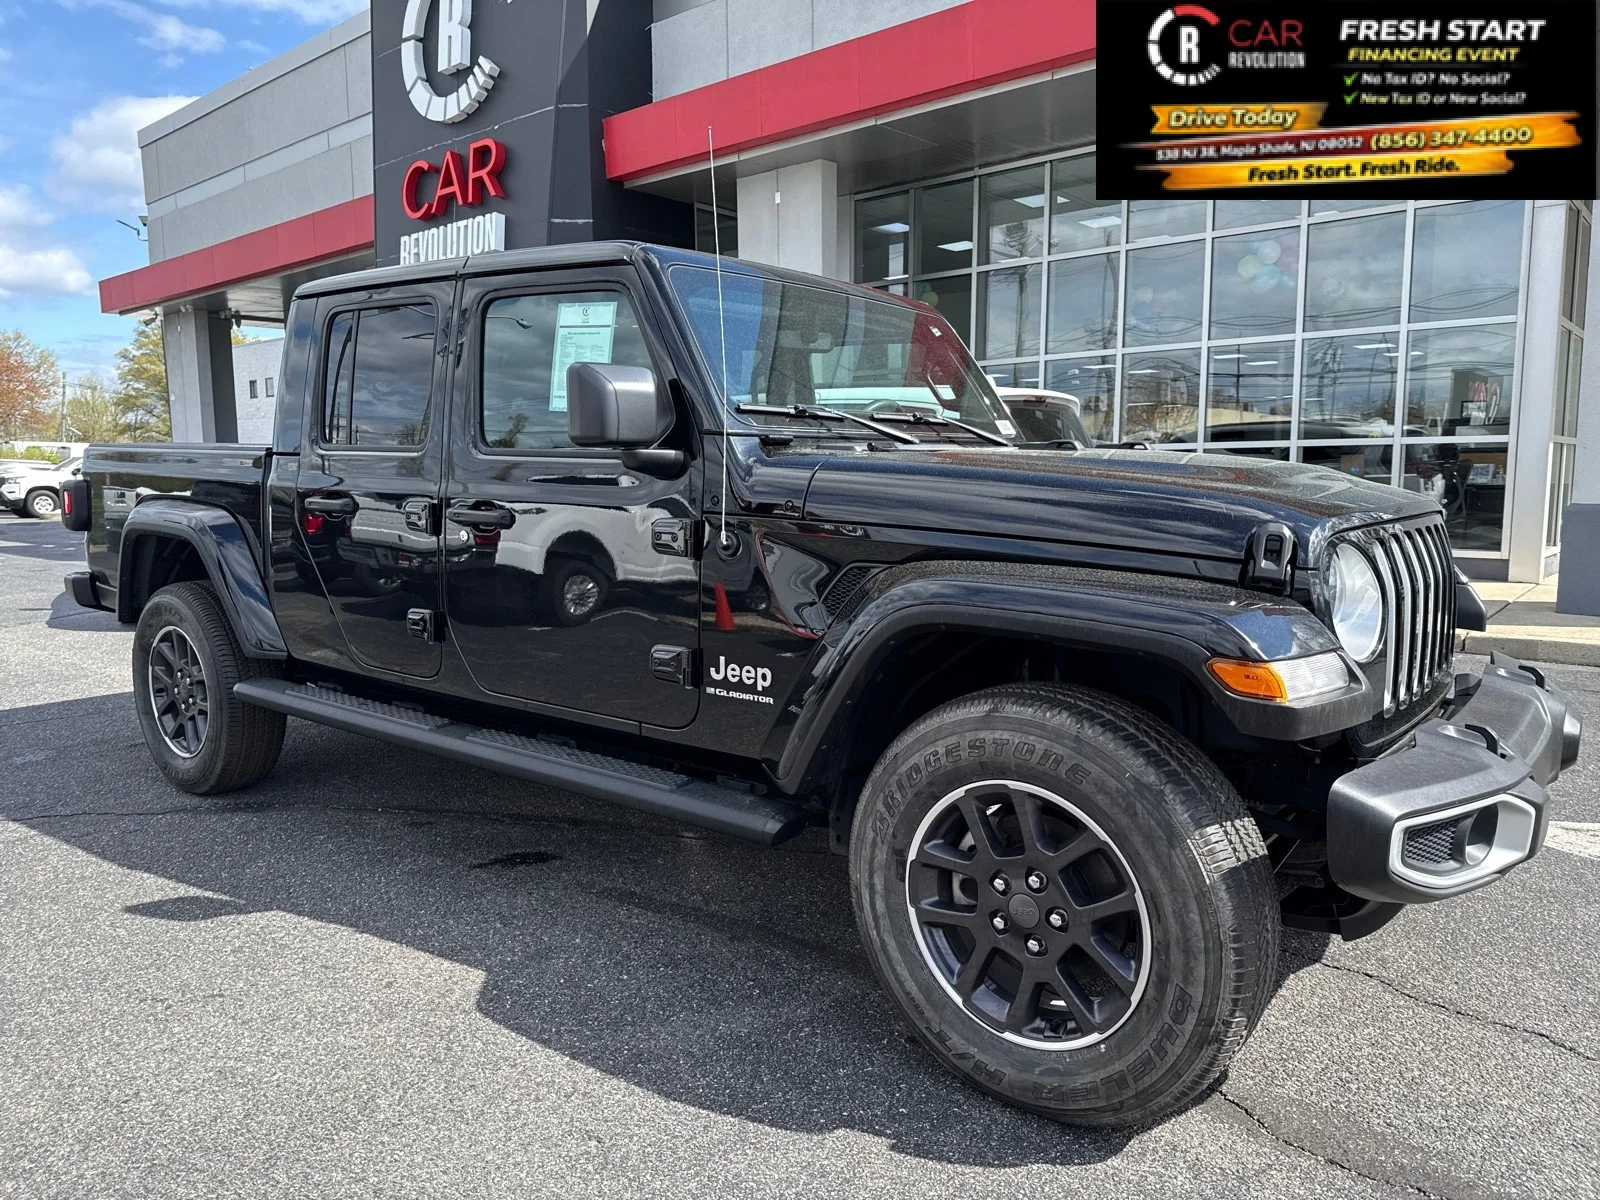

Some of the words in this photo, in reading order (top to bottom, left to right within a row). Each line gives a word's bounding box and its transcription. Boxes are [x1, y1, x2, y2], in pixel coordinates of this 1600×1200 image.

[402, 138, 506, 221] CAR
[400, 211, 506, 266] REVOLUTION
[709, 655, 772, 692] Jeep
[715, 687, 774, 705] GLADIATOR
[870, 737, 1093, 844] BRIDGESTONE
[1031, 983, 1193, 1102] DUELER
